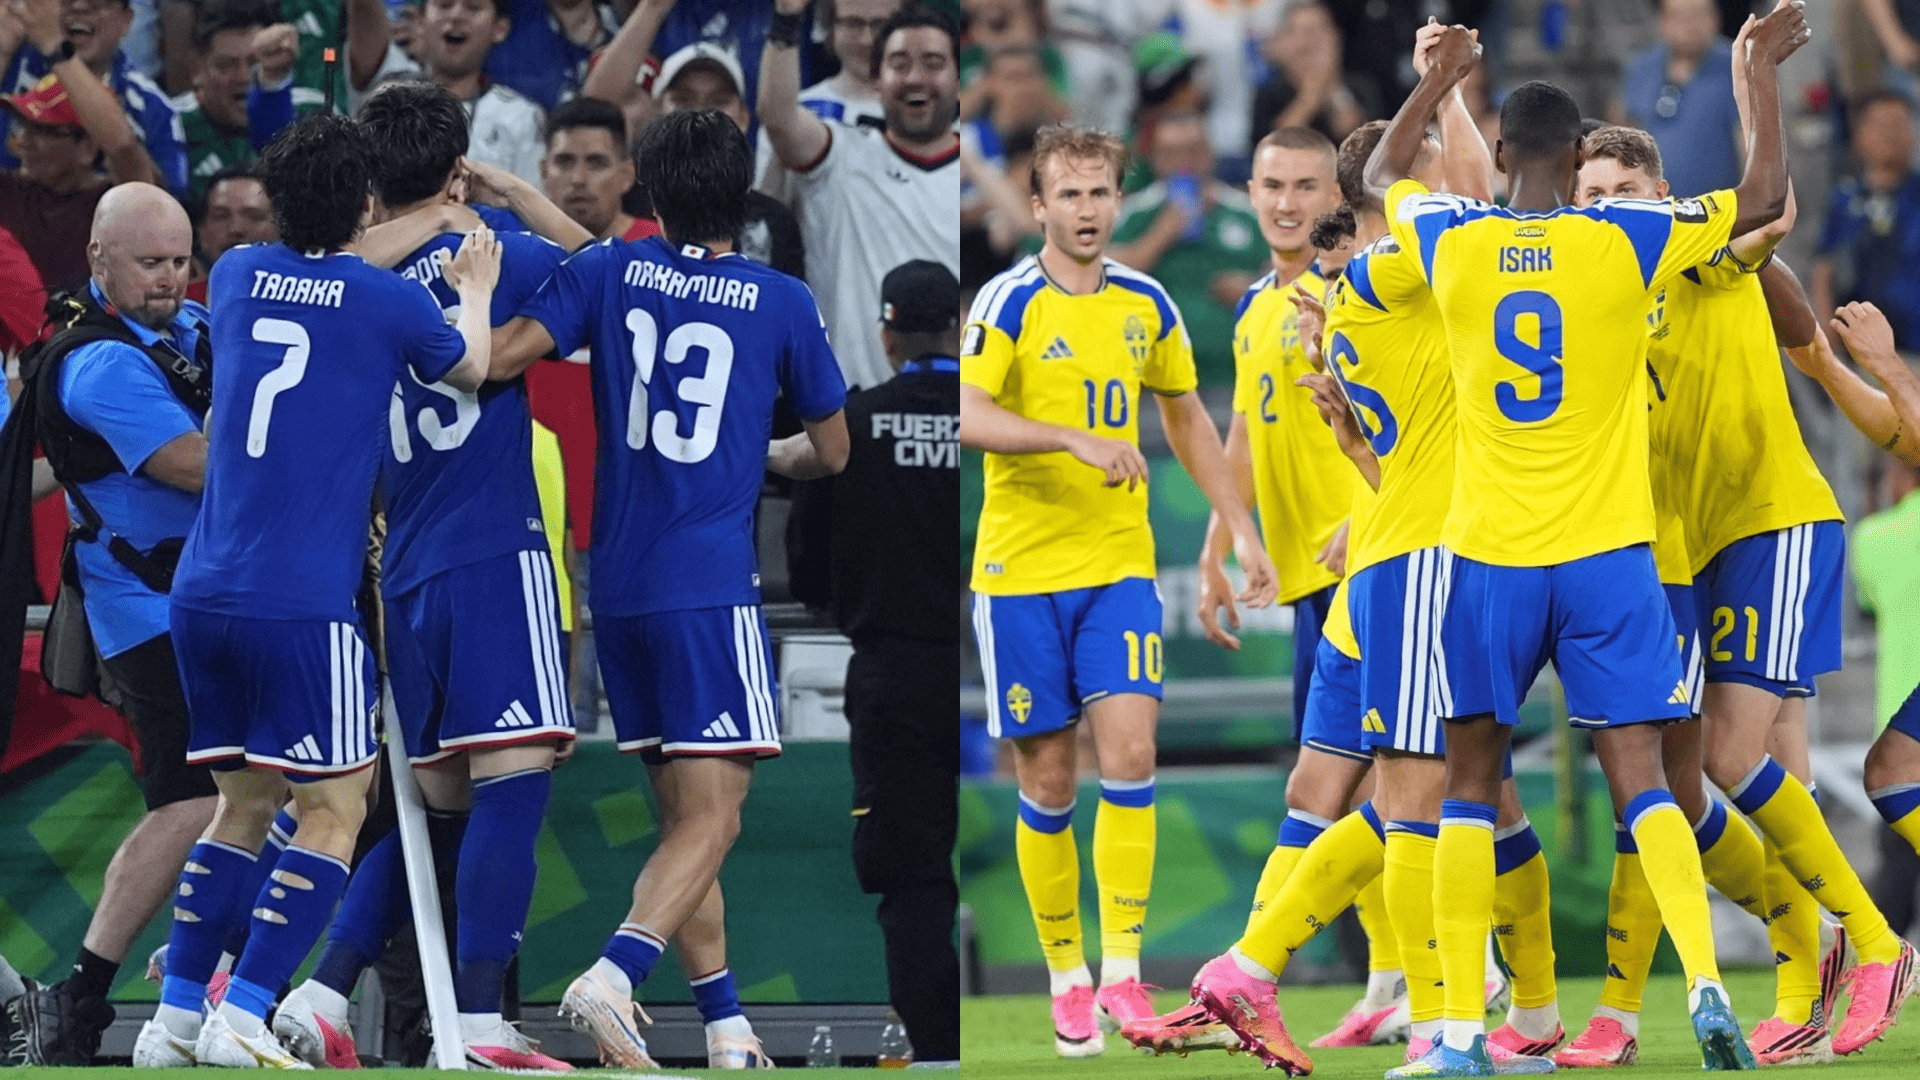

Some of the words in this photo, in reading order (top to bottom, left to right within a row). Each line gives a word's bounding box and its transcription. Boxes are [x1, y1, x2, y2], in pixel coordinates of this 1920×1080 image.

[1499, 246, 1552, 273] ISAK
[251, 270, 345, 308] TANAKA
[624, 260, 759, 311] NAKAMURA
[1494, 291, 1563, 422] 9
[247, 317, 311, 458] 7
[625, 308, 734, 463] 13
[1084, 379, 1128, 429] 10
[1260, 374, 1278, 423] 2
[894, 440, 960, 468] CIVI
[1123, 630, 1163, 684] 10
[1711, 606, 1758, 662] 21
